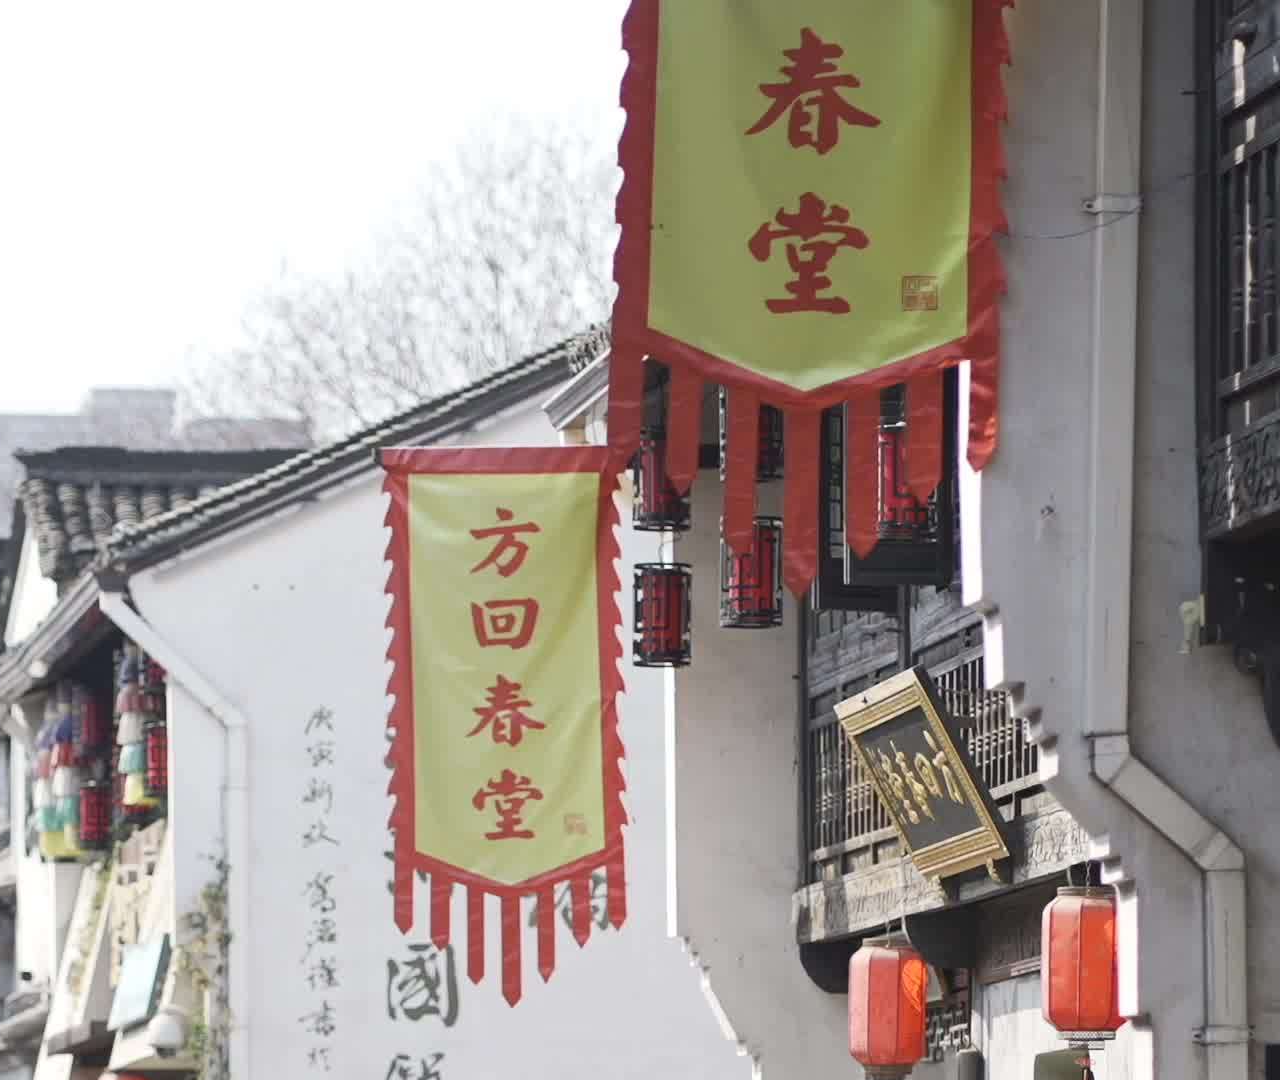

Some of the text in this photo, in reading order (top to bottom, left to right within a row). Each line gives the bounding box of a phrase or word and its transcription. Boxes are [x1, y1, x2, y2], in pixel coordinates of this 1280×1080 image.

[743, 27, 882, 314] 春堂
[465, 506, 547, 840] 方回春堂
